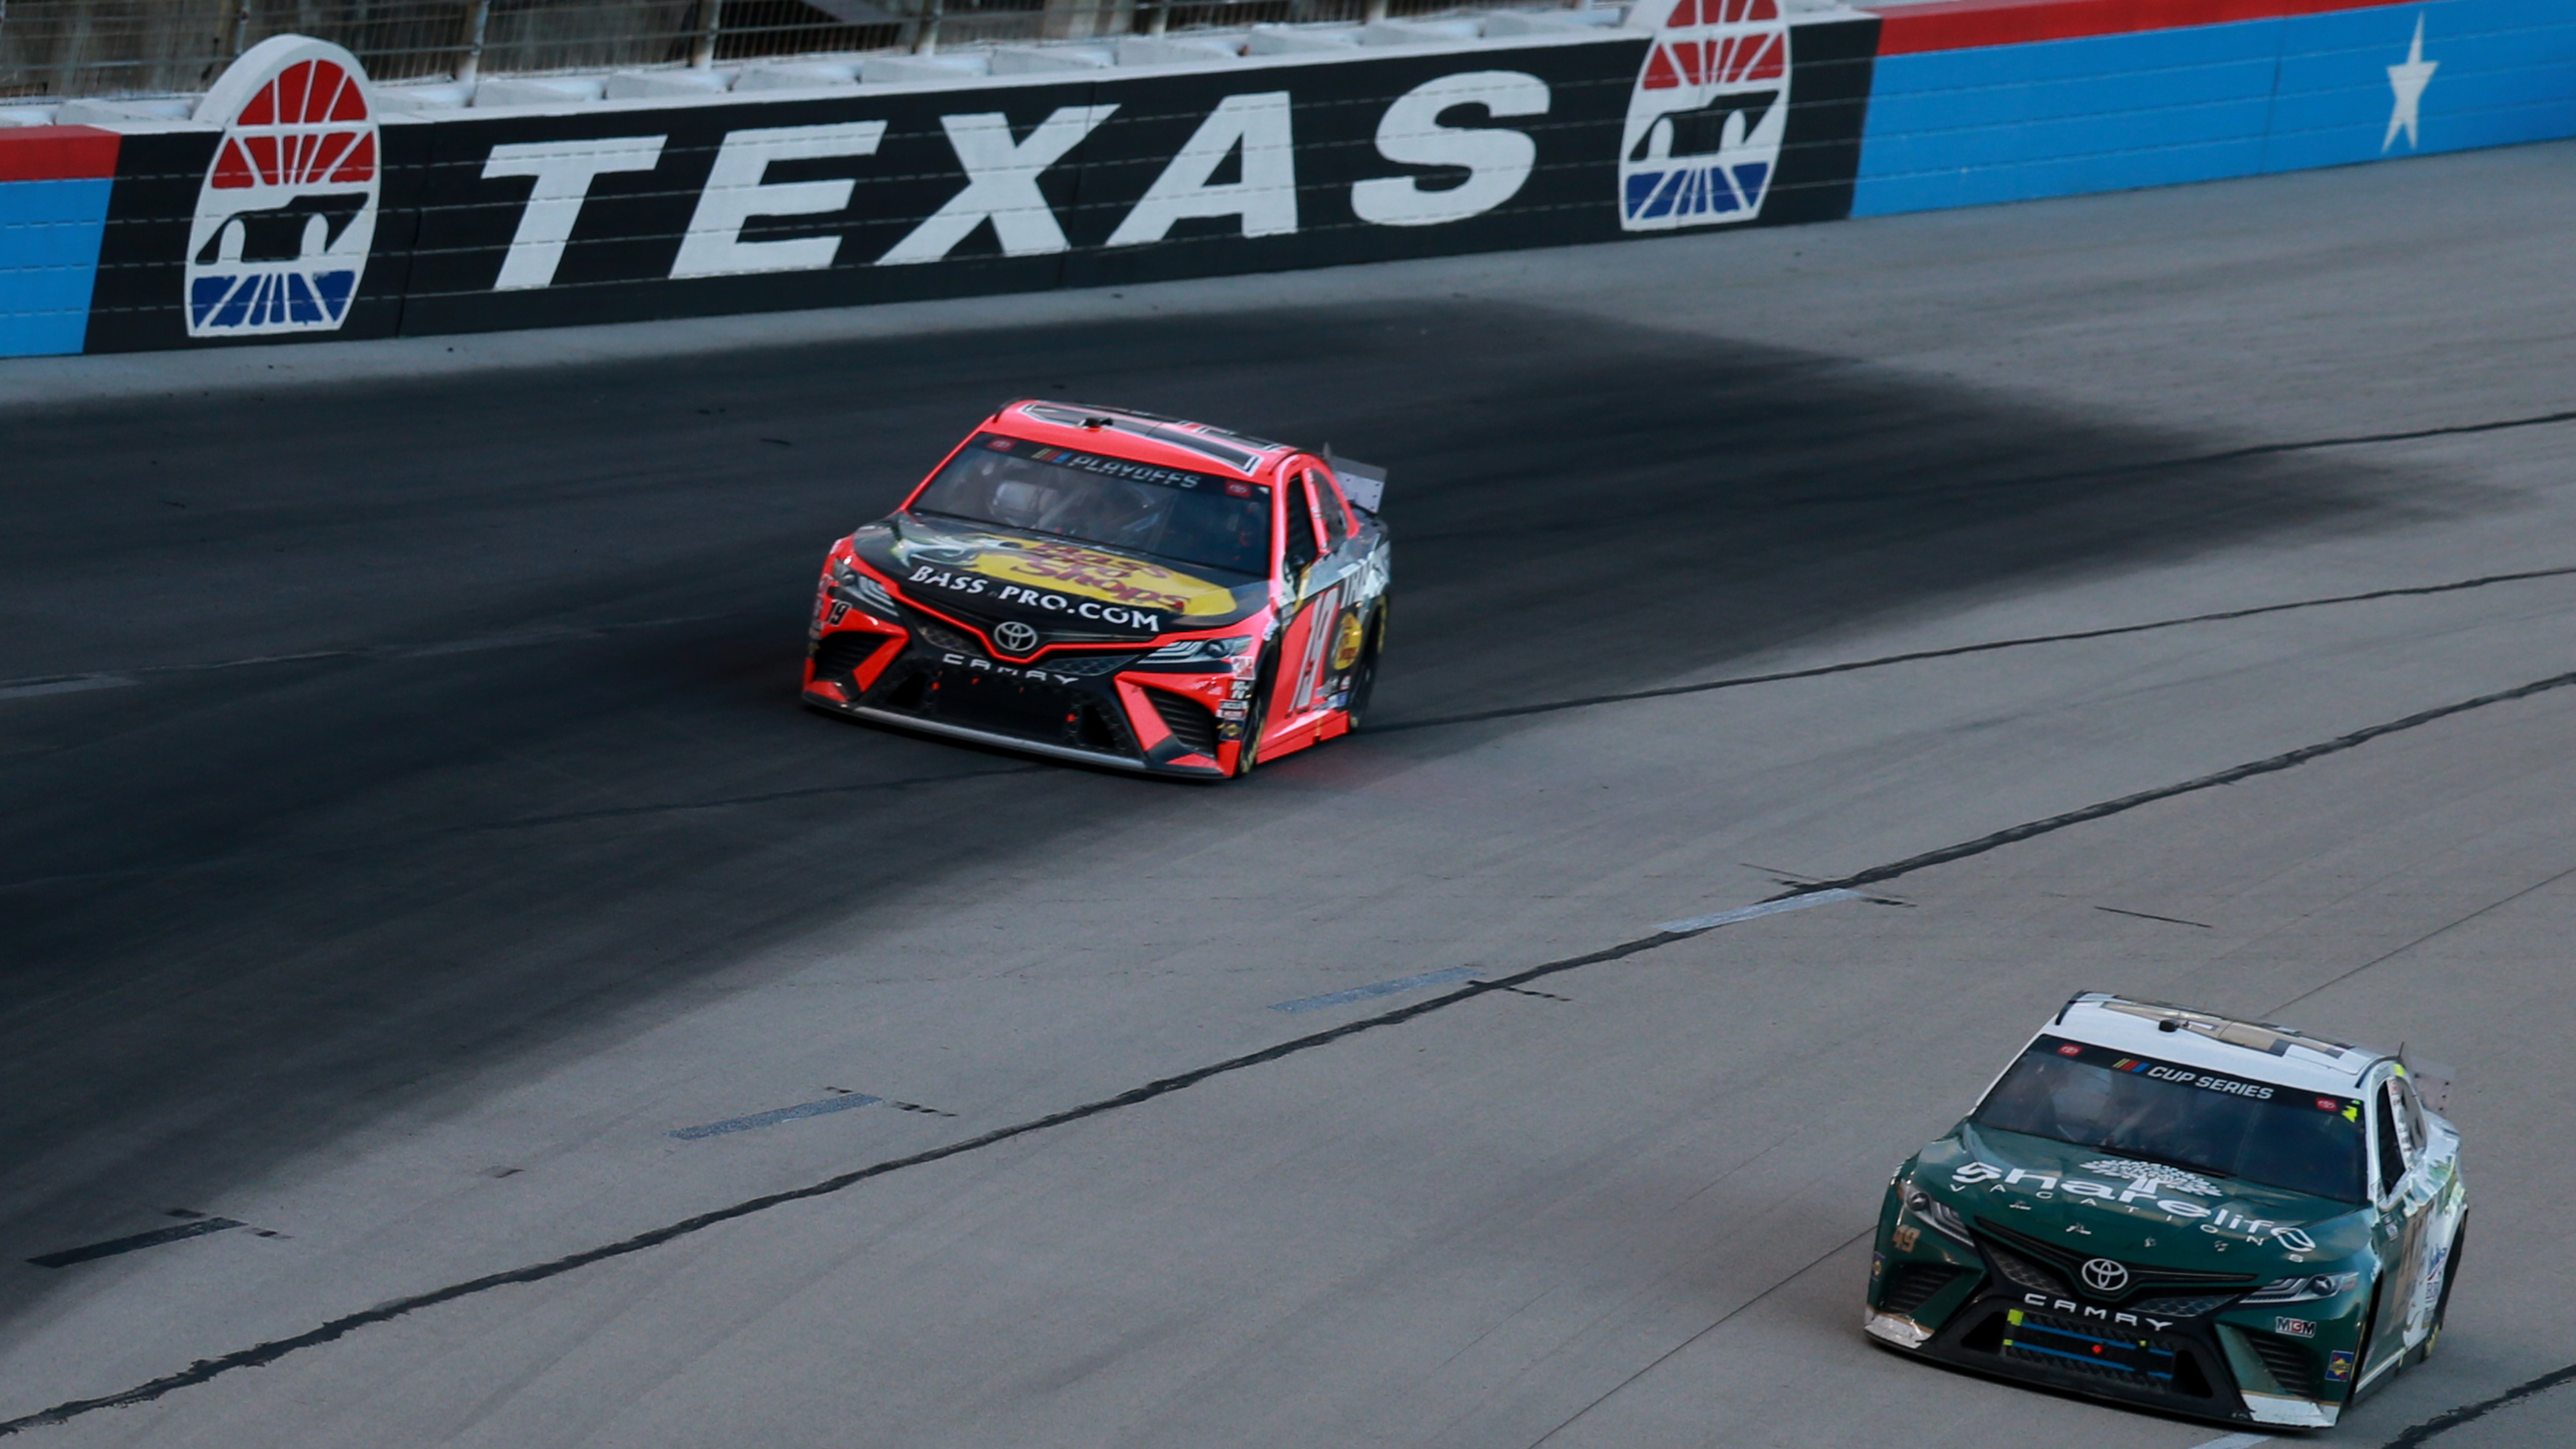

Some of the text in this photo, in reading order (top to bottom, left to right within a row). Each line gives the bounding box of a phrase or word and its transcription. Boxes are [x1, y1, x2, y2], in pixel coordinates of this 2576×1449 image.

[481, 70, 1551, 292] TEXAS
[1068, 454, 1201, 488] PLAYOFFS
[908, 565, 1160, 632] BASS PRO.COM
[1010, 561, 1190, 613] Shops
[824, 600, 853, 627] 19
[942, 652, 1079, 684] CAMRY
[1288, 586, 1339, 715] 19
[2147, 1066, 2274, 1099] CUP SERIES
[1950, 1184, 2304, 1263] VACATIONS
[2024, 1292, 2174, 1331] CAMRY
